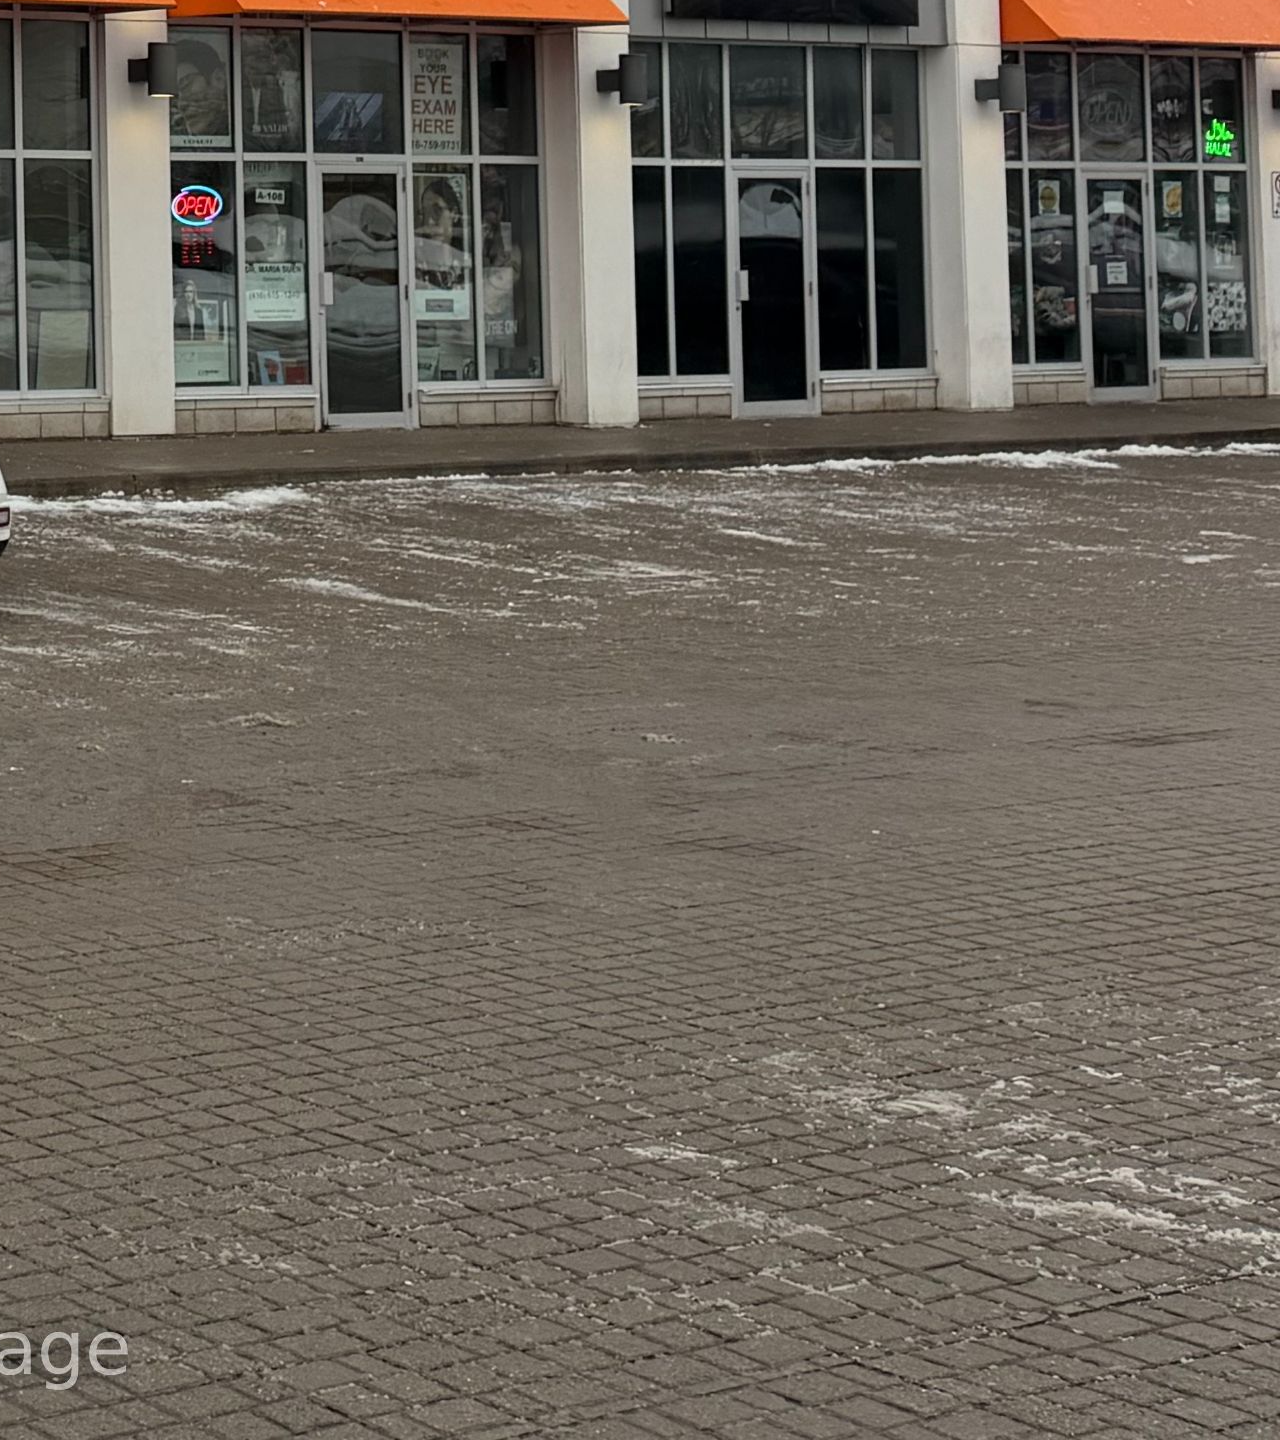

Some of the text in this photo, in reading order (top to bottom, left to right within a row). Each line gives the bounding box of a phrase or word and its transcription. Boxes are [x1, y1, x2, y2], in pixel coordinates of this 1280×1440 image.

[418, 48, 449, 59] BOOK
[420, 63, 447, 74] YOUR
[414, 75, 453, 95] EYE
[412, 99, 456, 115] EXAM
[412, 118, 454, 135] HERE
[1205, 141, 1232, 157] HALAL
[256, 191, 283, 201] A-108
[175, 196, 218, 217] OPEN
